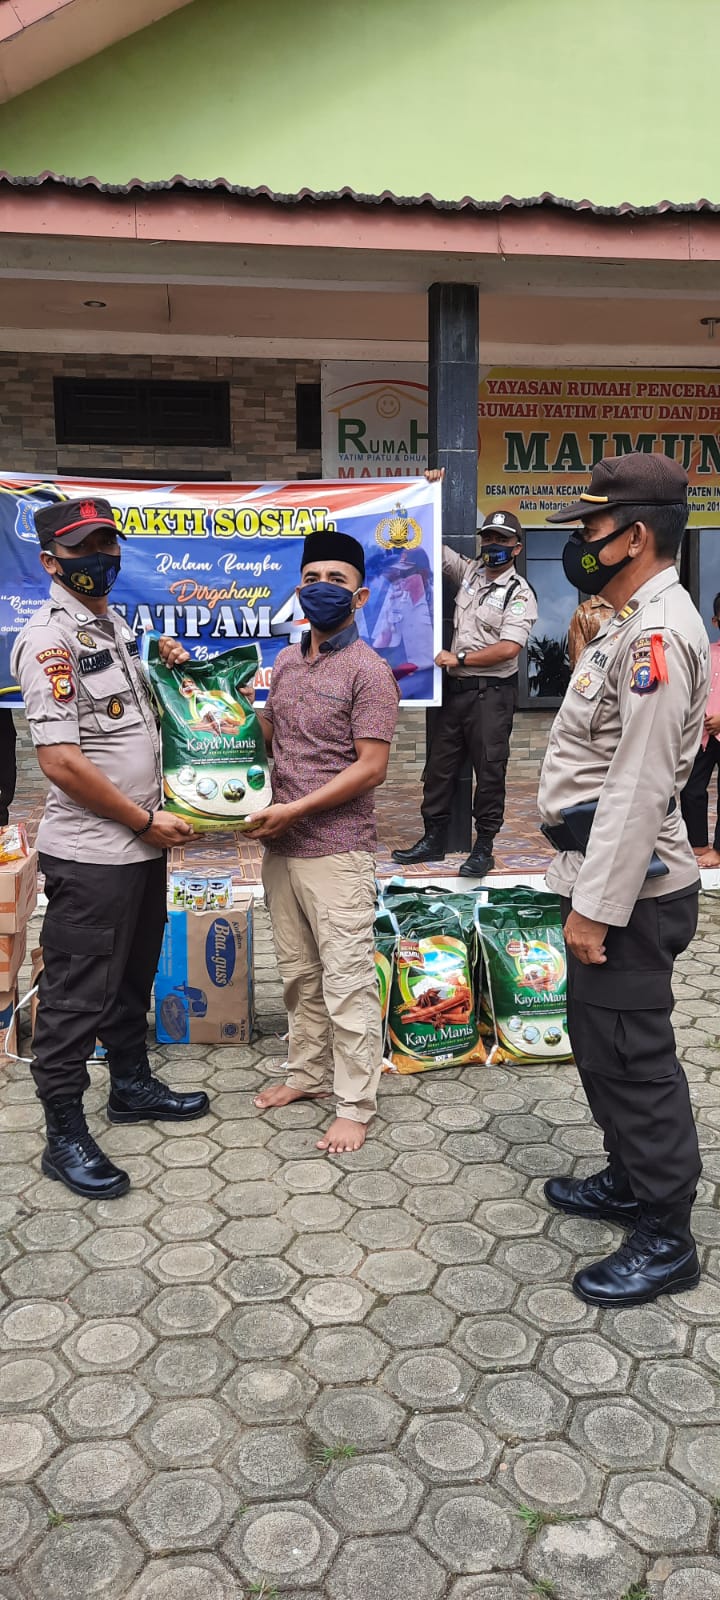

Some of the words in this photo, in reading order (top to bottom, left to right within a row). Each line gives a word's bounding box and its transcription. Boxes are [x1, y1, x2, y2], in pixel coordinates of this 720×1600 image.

[486, 380, 562, 395] YAYASAN
[566, 381, 631, 397] RUMAH
[635, 383, 720, 398] PENCERA
[477, 402, 538, 417] RUMAH
[542, 404, 598, 418] YATIM
[601, 405, 654, 419] PIATU
[658, 405, 693, 420] DAN
[339, 454, 364, 462] YATIM
[366, 454, 391, 462] PIATU
[338, 466, 428, 479] MAIMU
[485, 485, 507, 496] DESA
[508, 485, 530, 496] KOTA
[532, 485, 554, 496] LAMA
[687, 486, 712, 497] PATEN
[520, 501, 537, 511] Akta
[687, 501, 705, 511] ahun
[214, 506, 334, 538] SOSIAL
[155, 552, 213, 576] Dalam
[169, 578, 271, 608] Dirgahayu
[38, 648, 70, 661] POLDA
[46, 663, 70, 673] RIAU
[186, 737, 222, 755] Kayu
[222, 736, 257, 750] Manis
[513, 993, 540, 1008] Kayu
[542, 992, 566, 1003] Mani
[405, 1032, 437, 1048] Kayu
[439, 1025, 474, 1041] Manis
